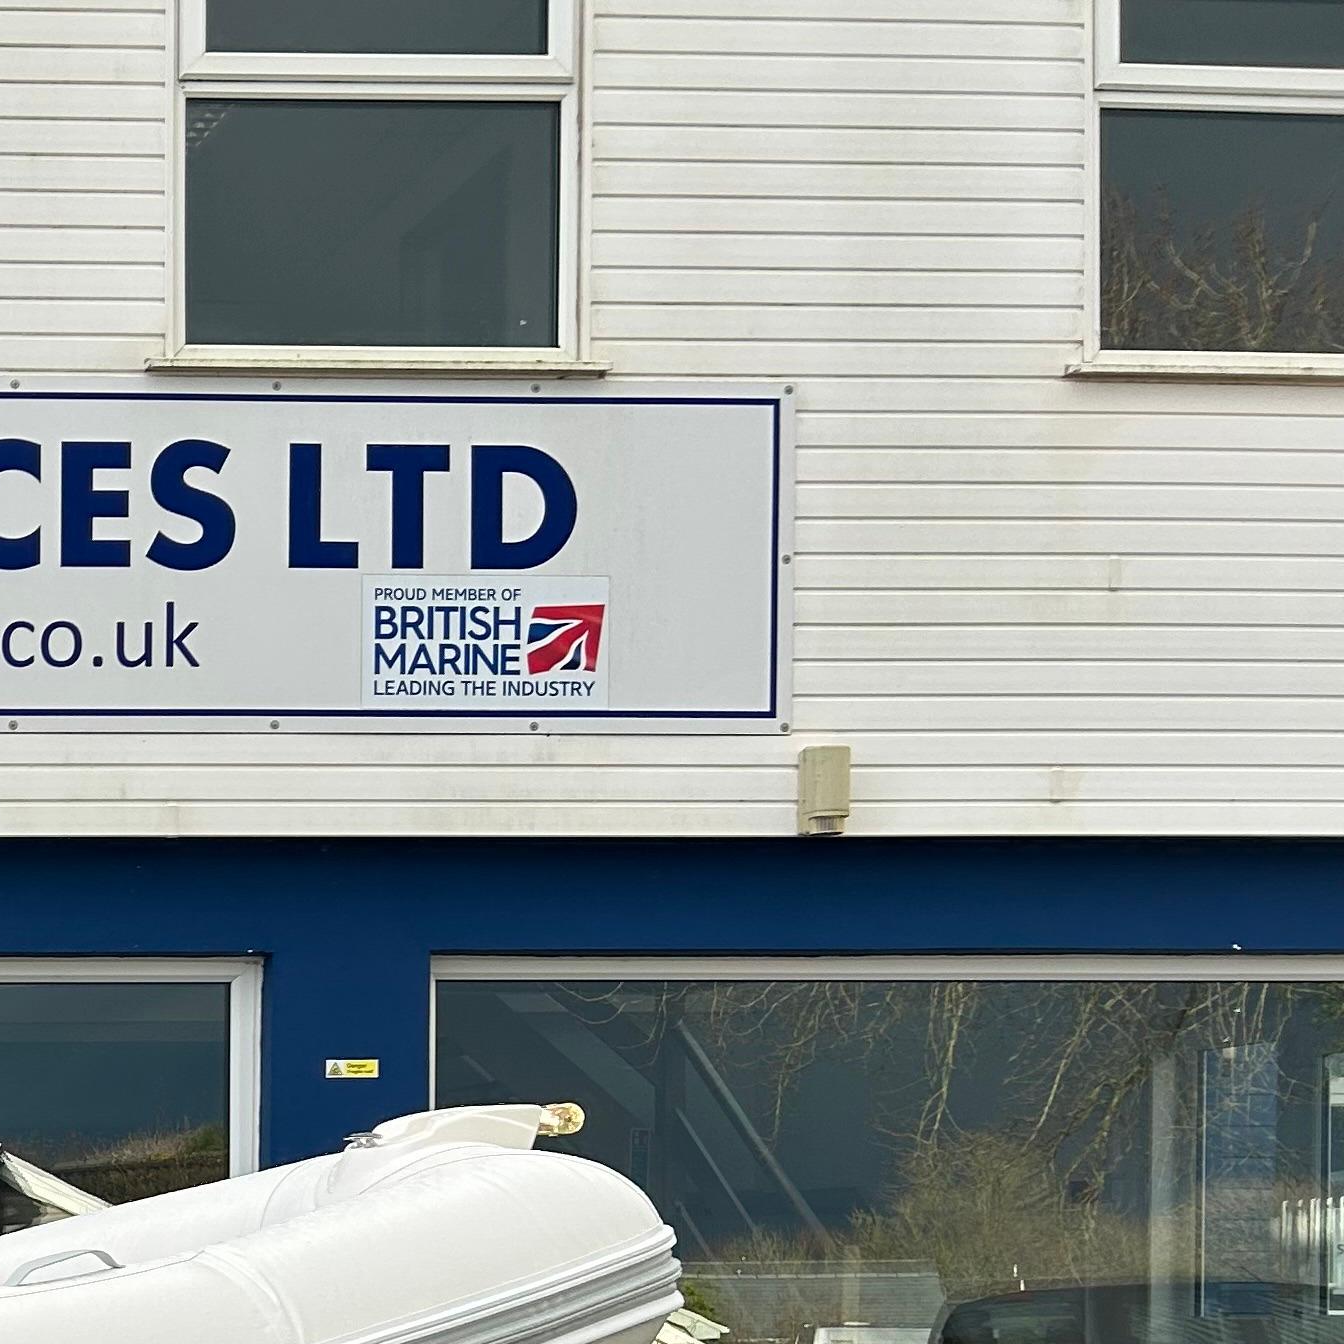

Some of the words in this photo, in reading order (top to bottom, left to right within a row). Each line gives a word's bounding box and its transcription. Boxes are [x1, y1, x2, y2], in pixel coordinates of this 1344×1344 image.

[288, 443, 578, 569] LTD
[374, 588, 426, 600] PROUD
[432, 588, 496, 600] MEMBER
[502, 589, 522, 601] OF
[374, 605, 522, 641] BRITISH
[374, 642, 521, 676] MARINE
[374, 680, 454, 696] LEADING
[461, 681, 496, 696] THE
[503, 681, 596, 697] INDUSTRY
